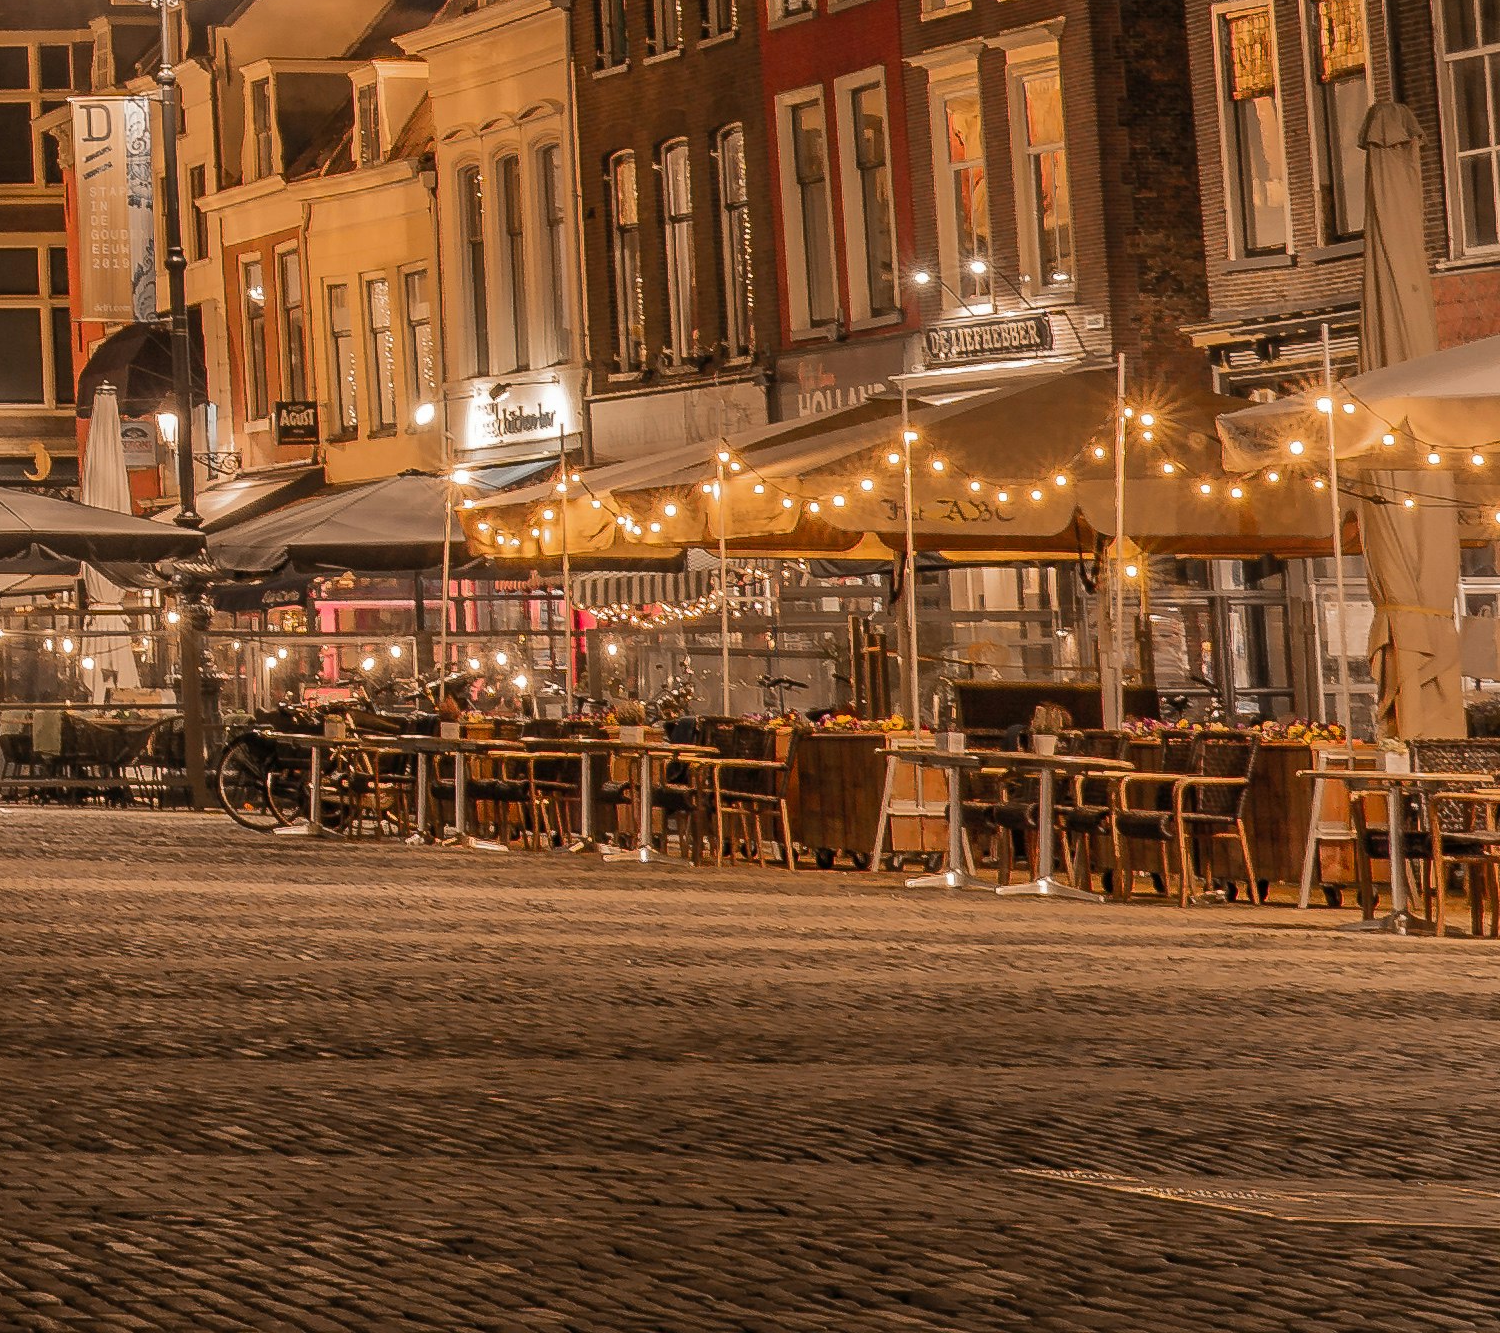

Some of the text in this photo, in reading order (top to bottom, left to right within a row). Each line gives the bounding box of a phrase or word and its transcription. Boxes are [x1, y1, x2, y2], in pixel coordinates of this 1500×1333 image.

[78, 104, 112, 143] D
[90, 200, 108, 212] IN
[90, 215, 108, 226] DE
[92, 258, 130, 269] 2019
[950, 320, 1040, 352] LIEFHEBBER
[936, 499, 1015, 522] ABC
